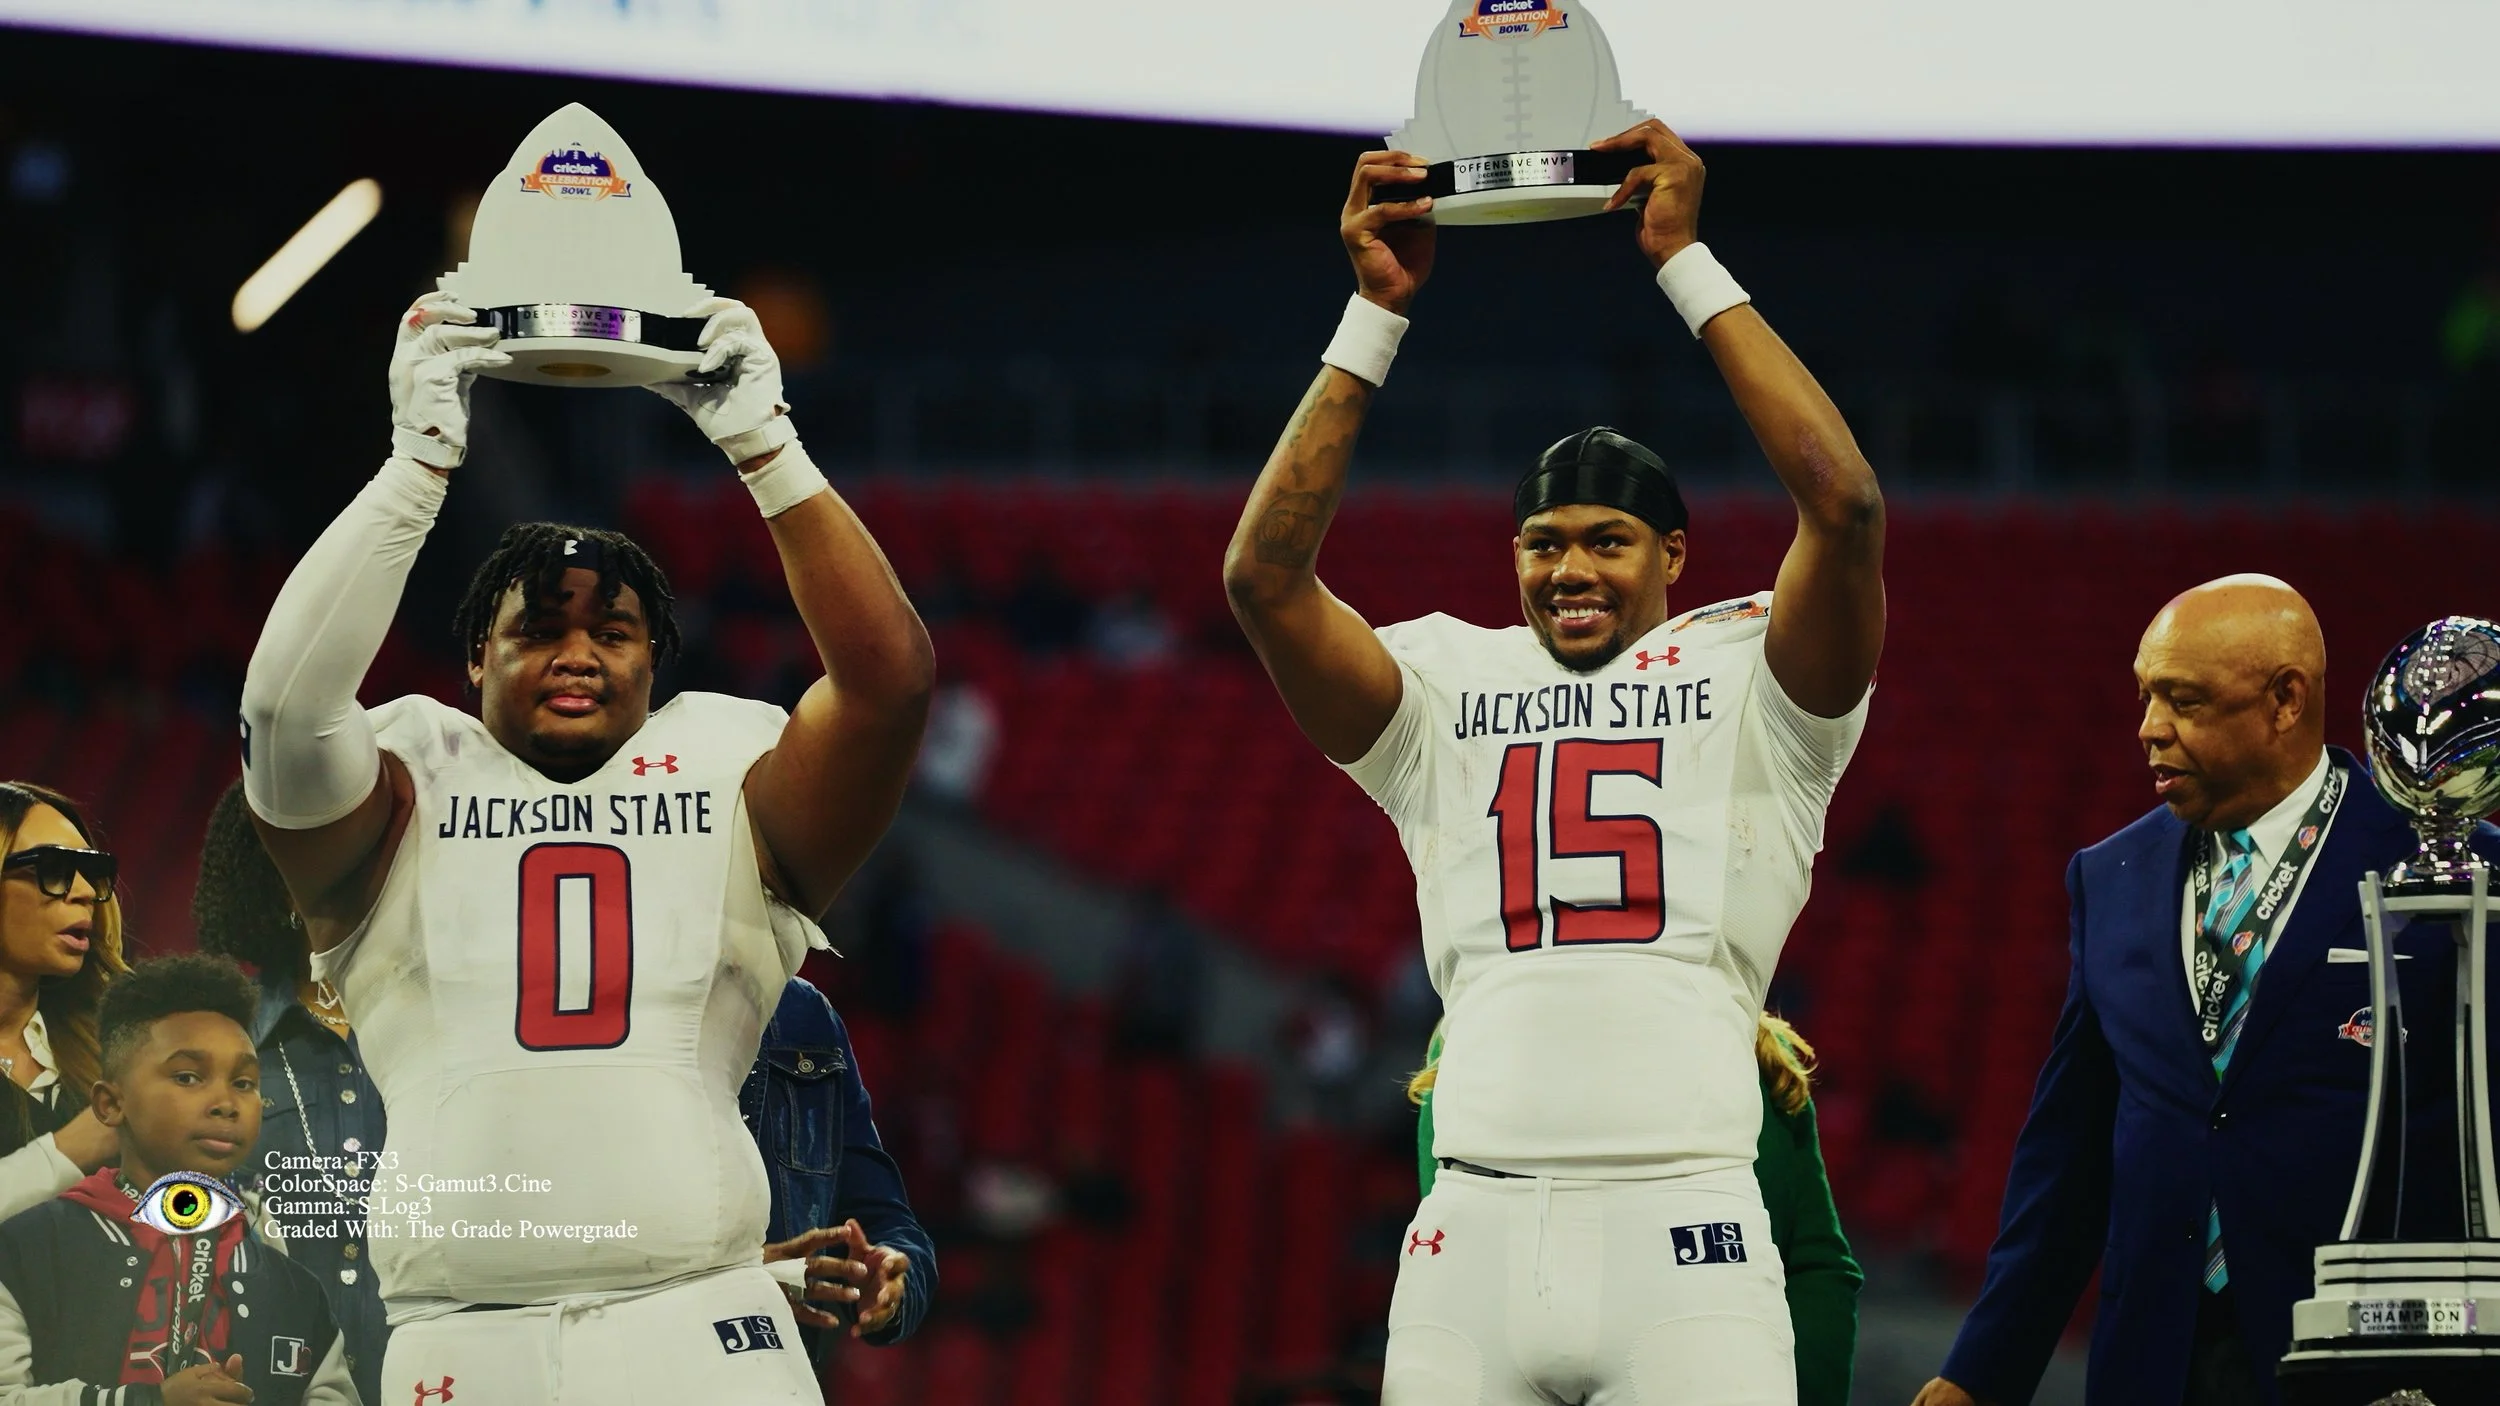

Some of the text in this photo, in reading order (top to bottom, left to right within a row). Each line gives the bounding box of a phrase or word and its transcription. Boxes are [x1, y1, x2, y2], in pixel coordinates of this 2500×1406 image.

[1477, 11, 1549, 25] CELEBRATION
[1490, 0, 1533, 12] cricket
[1499, 24, 1530, 34] BOWL
[539, 174, 613, 186] CELEBRATION
[553, 163, 598, 174] cricket
[1459, 157, 1532, 173] OFFENSIVE
[1540, 156, 1568, 166] MVP
[561, 187, 592, 195] BOWL
[1455, 678, 1712, 740] JACKSON STATE
[2319, 766, 2342, 814] crick
[439, 791, 712, 839] JACKSON STATE
[1487, 737, 1666, 953] 15
[2256, 860, 2299, 921] cricket
[514, 841, 634, 1052] 0
[2195, 950, 2212, 995] cric
[2201, 970, 2231, 1042] cricket
[188, 1238, 213, 1303] cricket
[2360, 1310, 2460, 1323] CHAMPION
